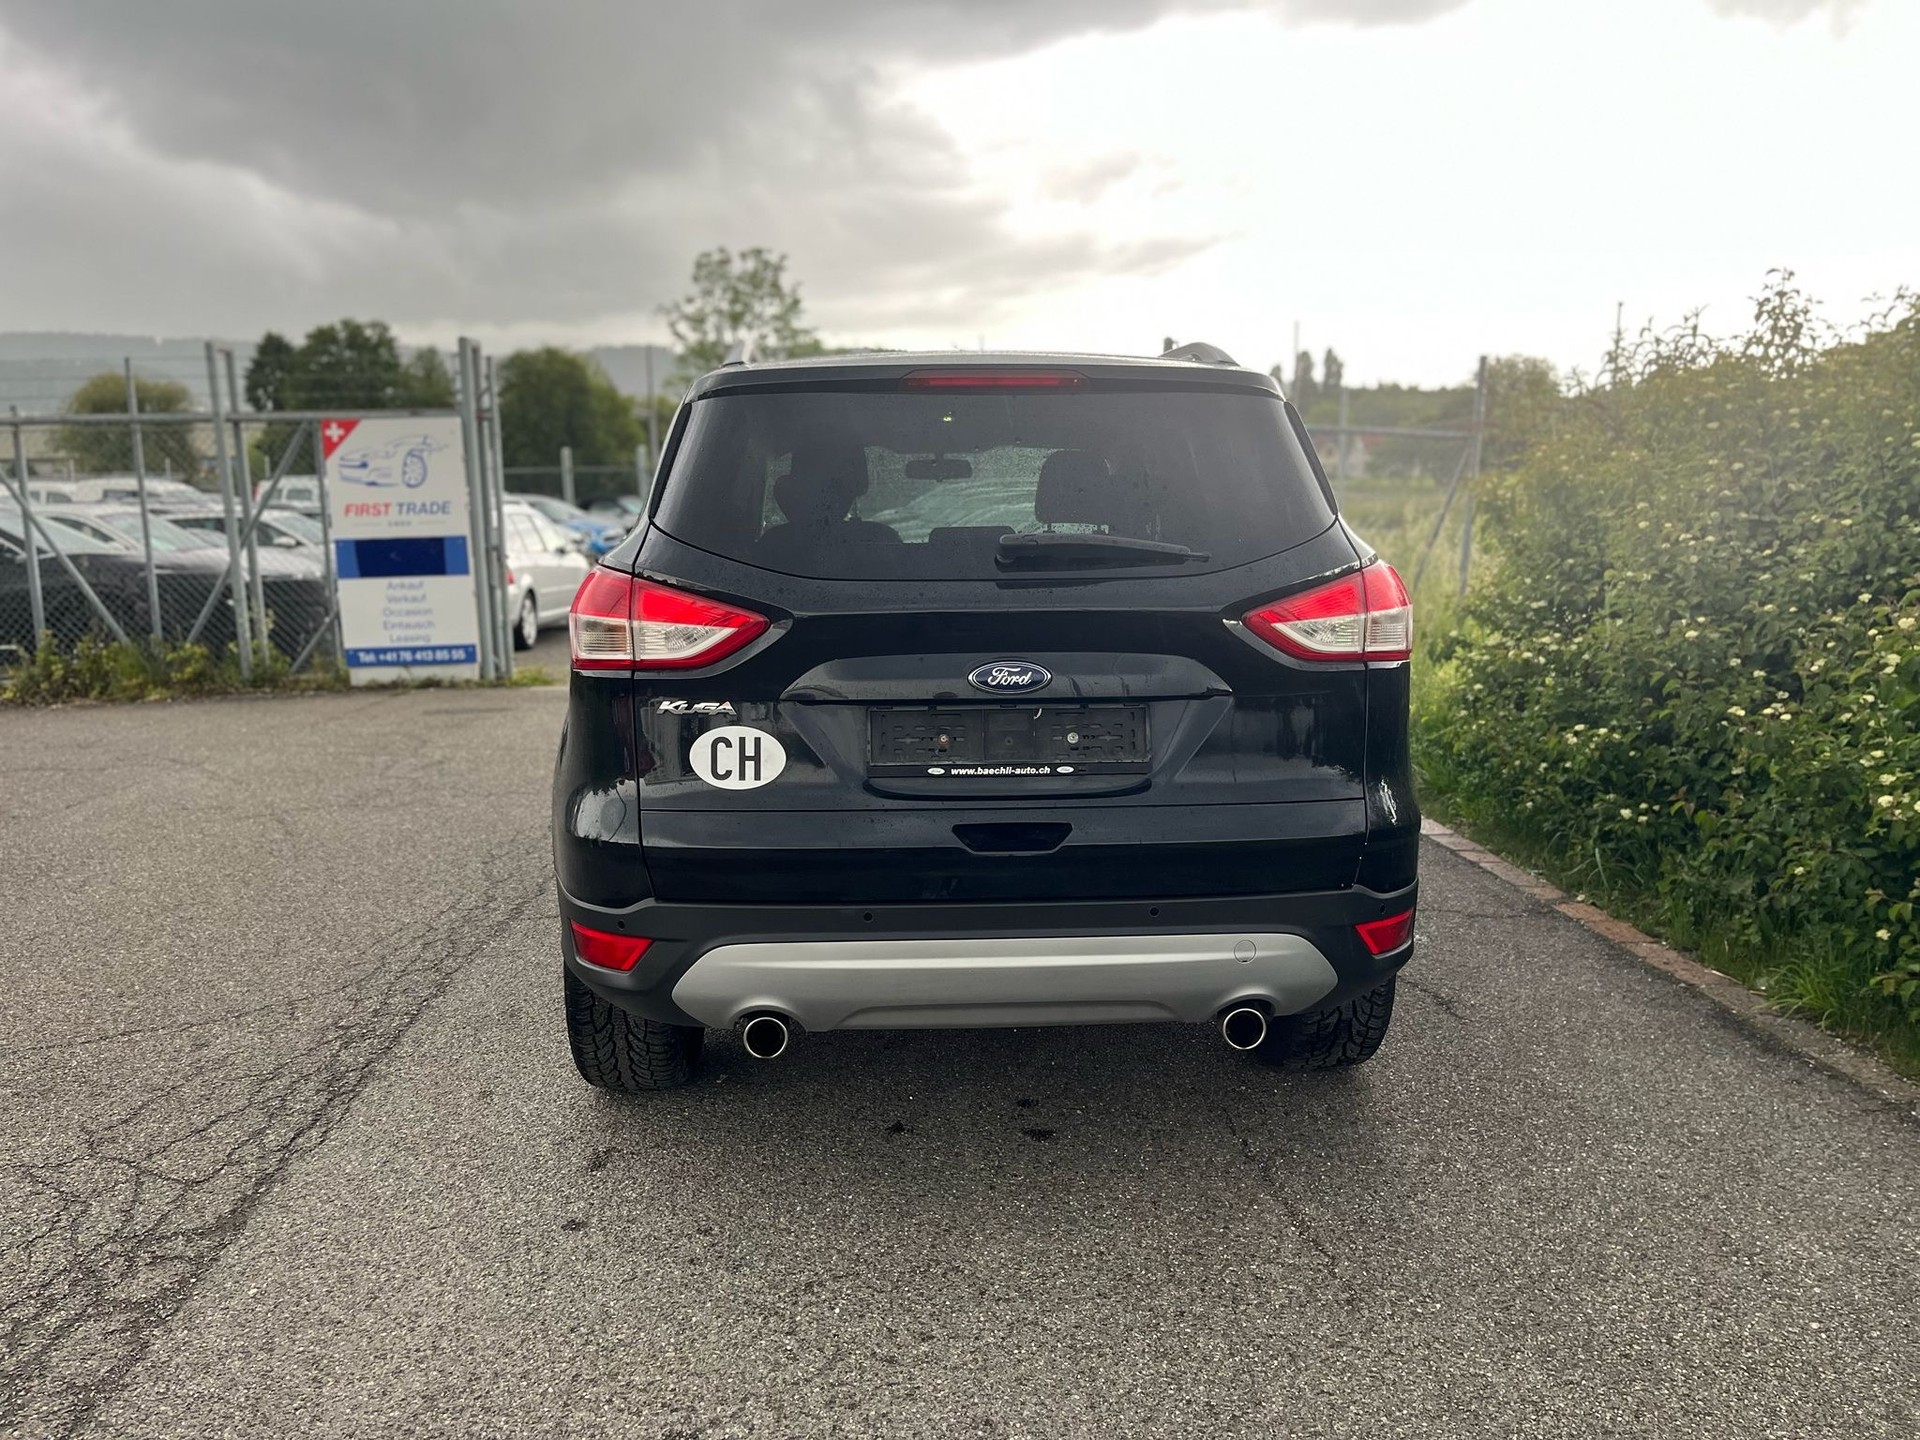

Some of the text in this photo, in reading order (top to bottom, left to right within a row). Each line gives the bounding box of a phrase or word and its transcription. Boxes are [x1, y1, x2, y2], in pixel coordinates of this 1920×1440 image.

[344, 501, 451, 517] FIRST TRADE
[987, 666, 1032, 686] Ford
[710, 736, 762, 781] CH
[950, 766, 1051, 776] www.baechli-auto.ch
